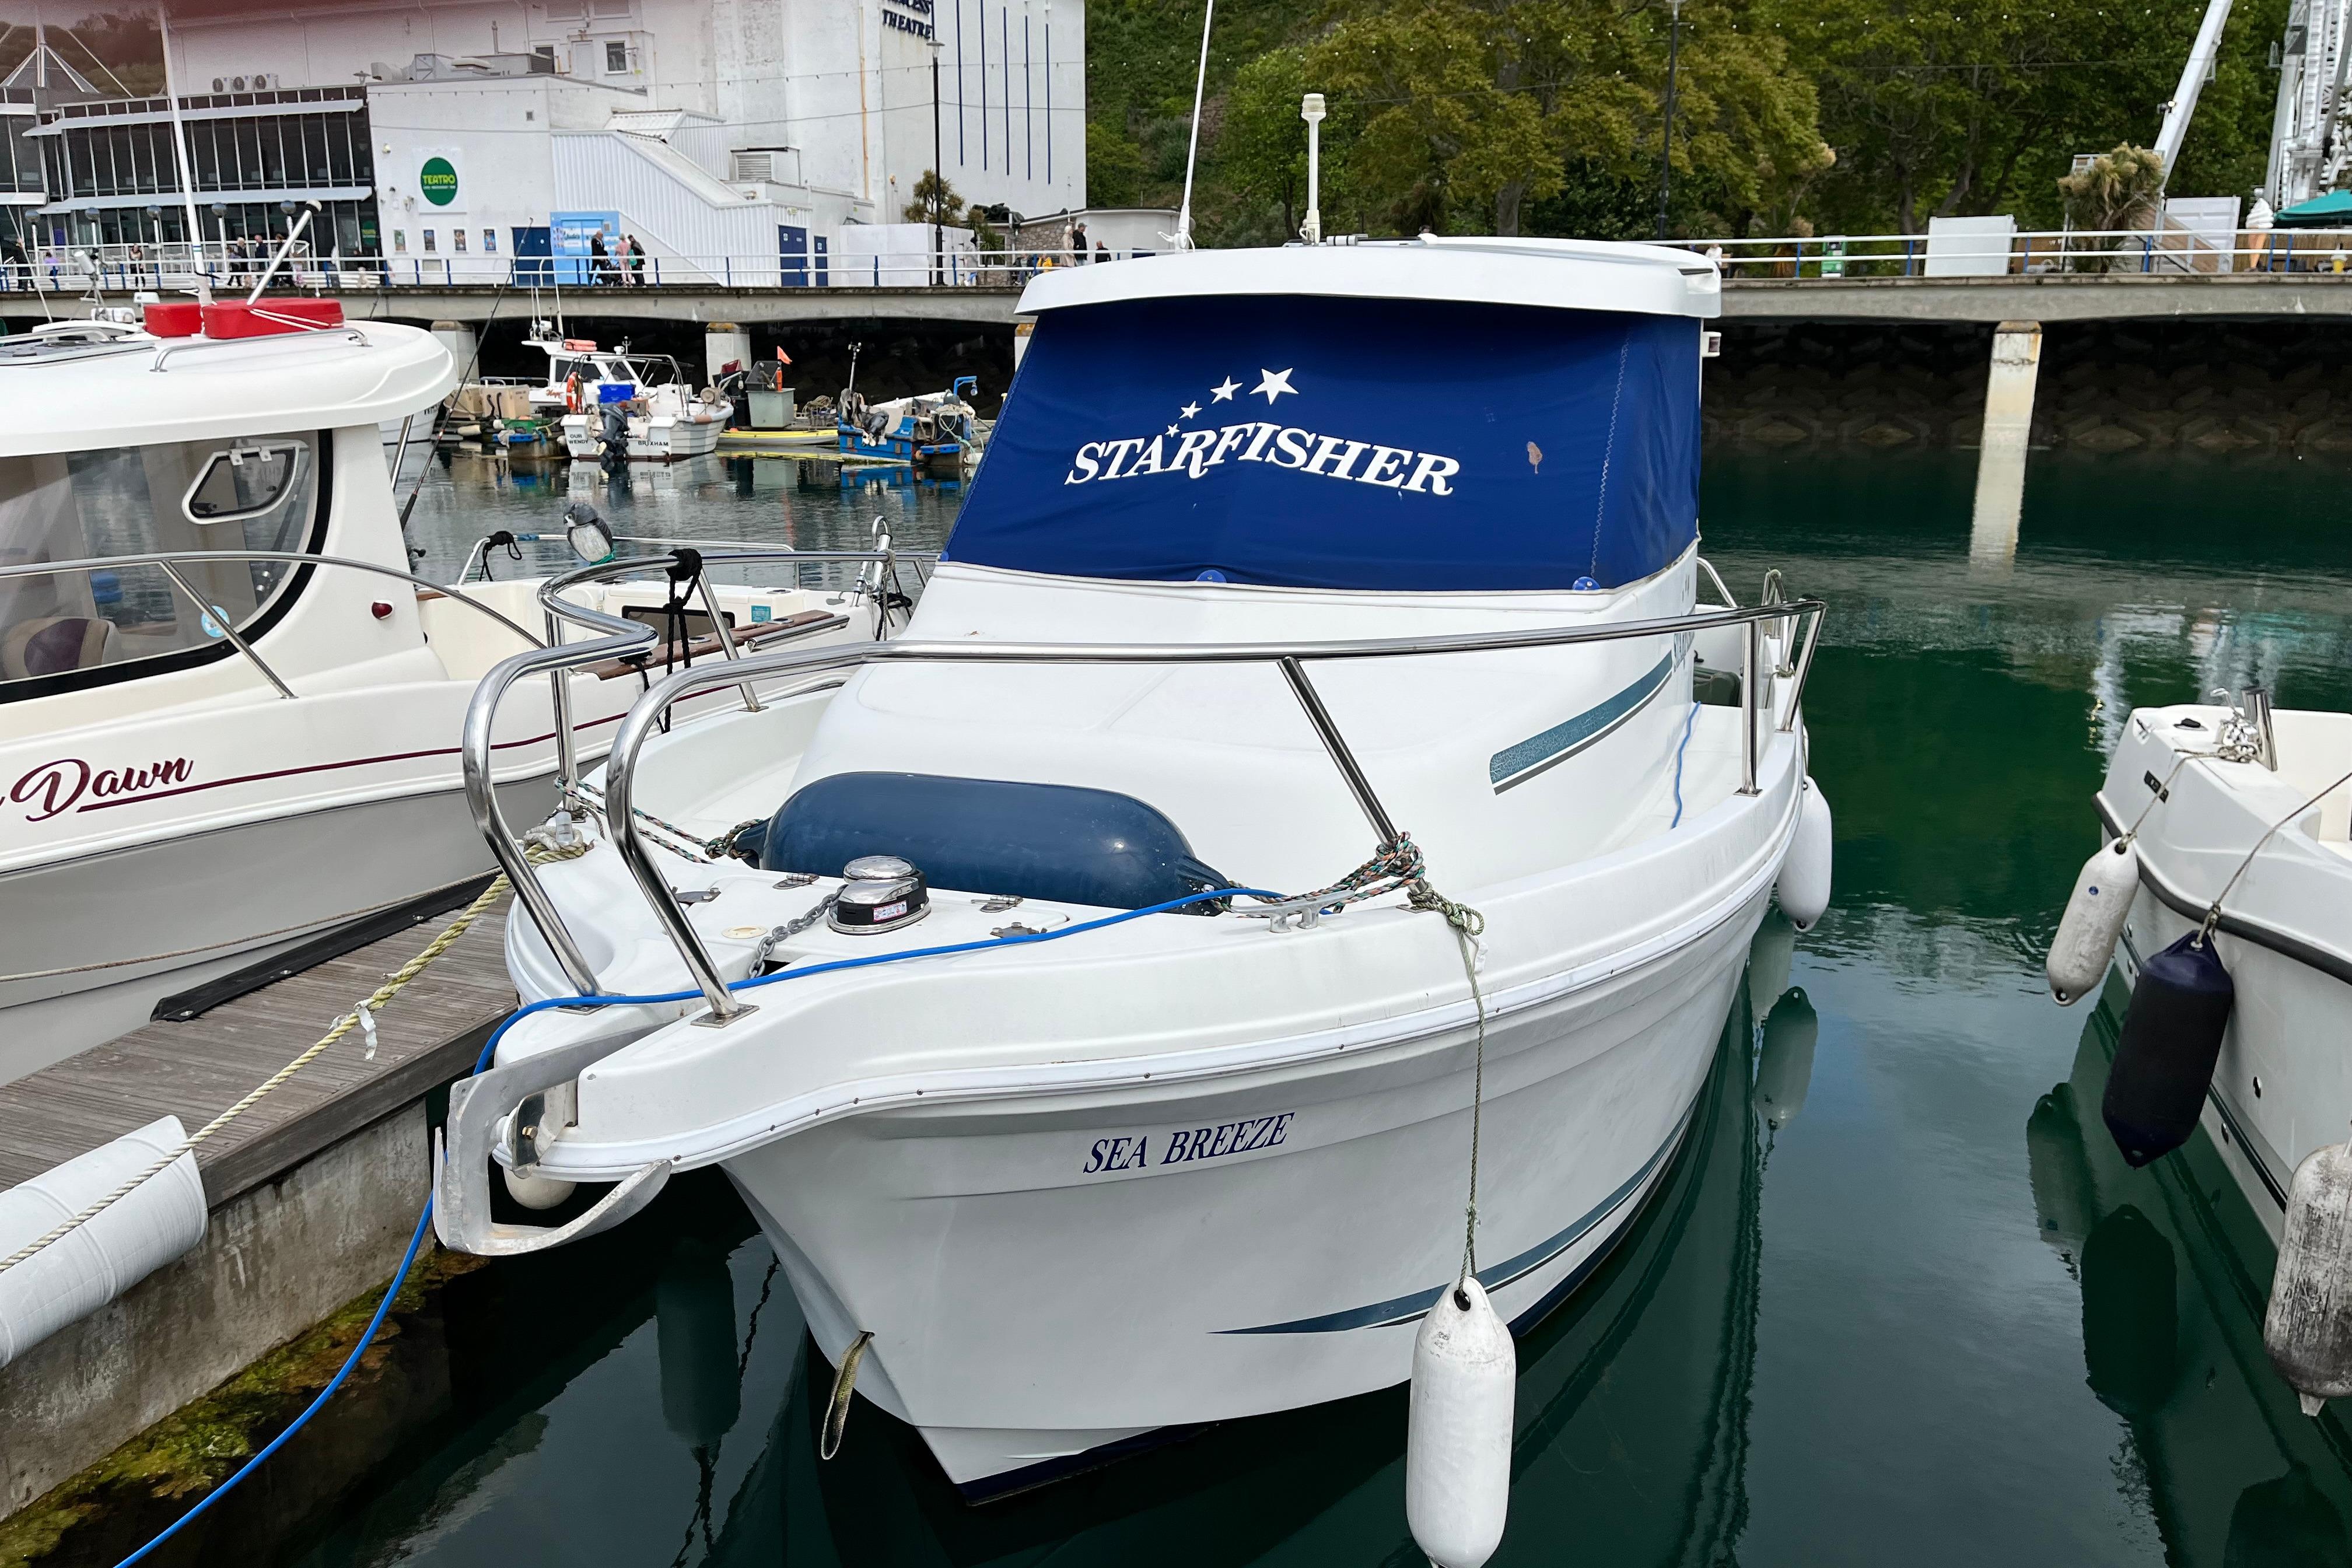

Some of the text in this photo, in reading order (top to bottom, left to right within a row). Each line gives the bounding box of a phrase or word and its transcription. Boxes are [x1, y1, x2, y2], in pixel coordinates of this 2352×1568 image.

[882, 9, 933, 39] THEATRE
[422, 174, 456, 184] TEATRO
[1064, 422, 1460, 496] STARFISHER
[10, 757, 194, 822] Dawn
[1083, 1112, 1296, 1174] SEA BREEZE
